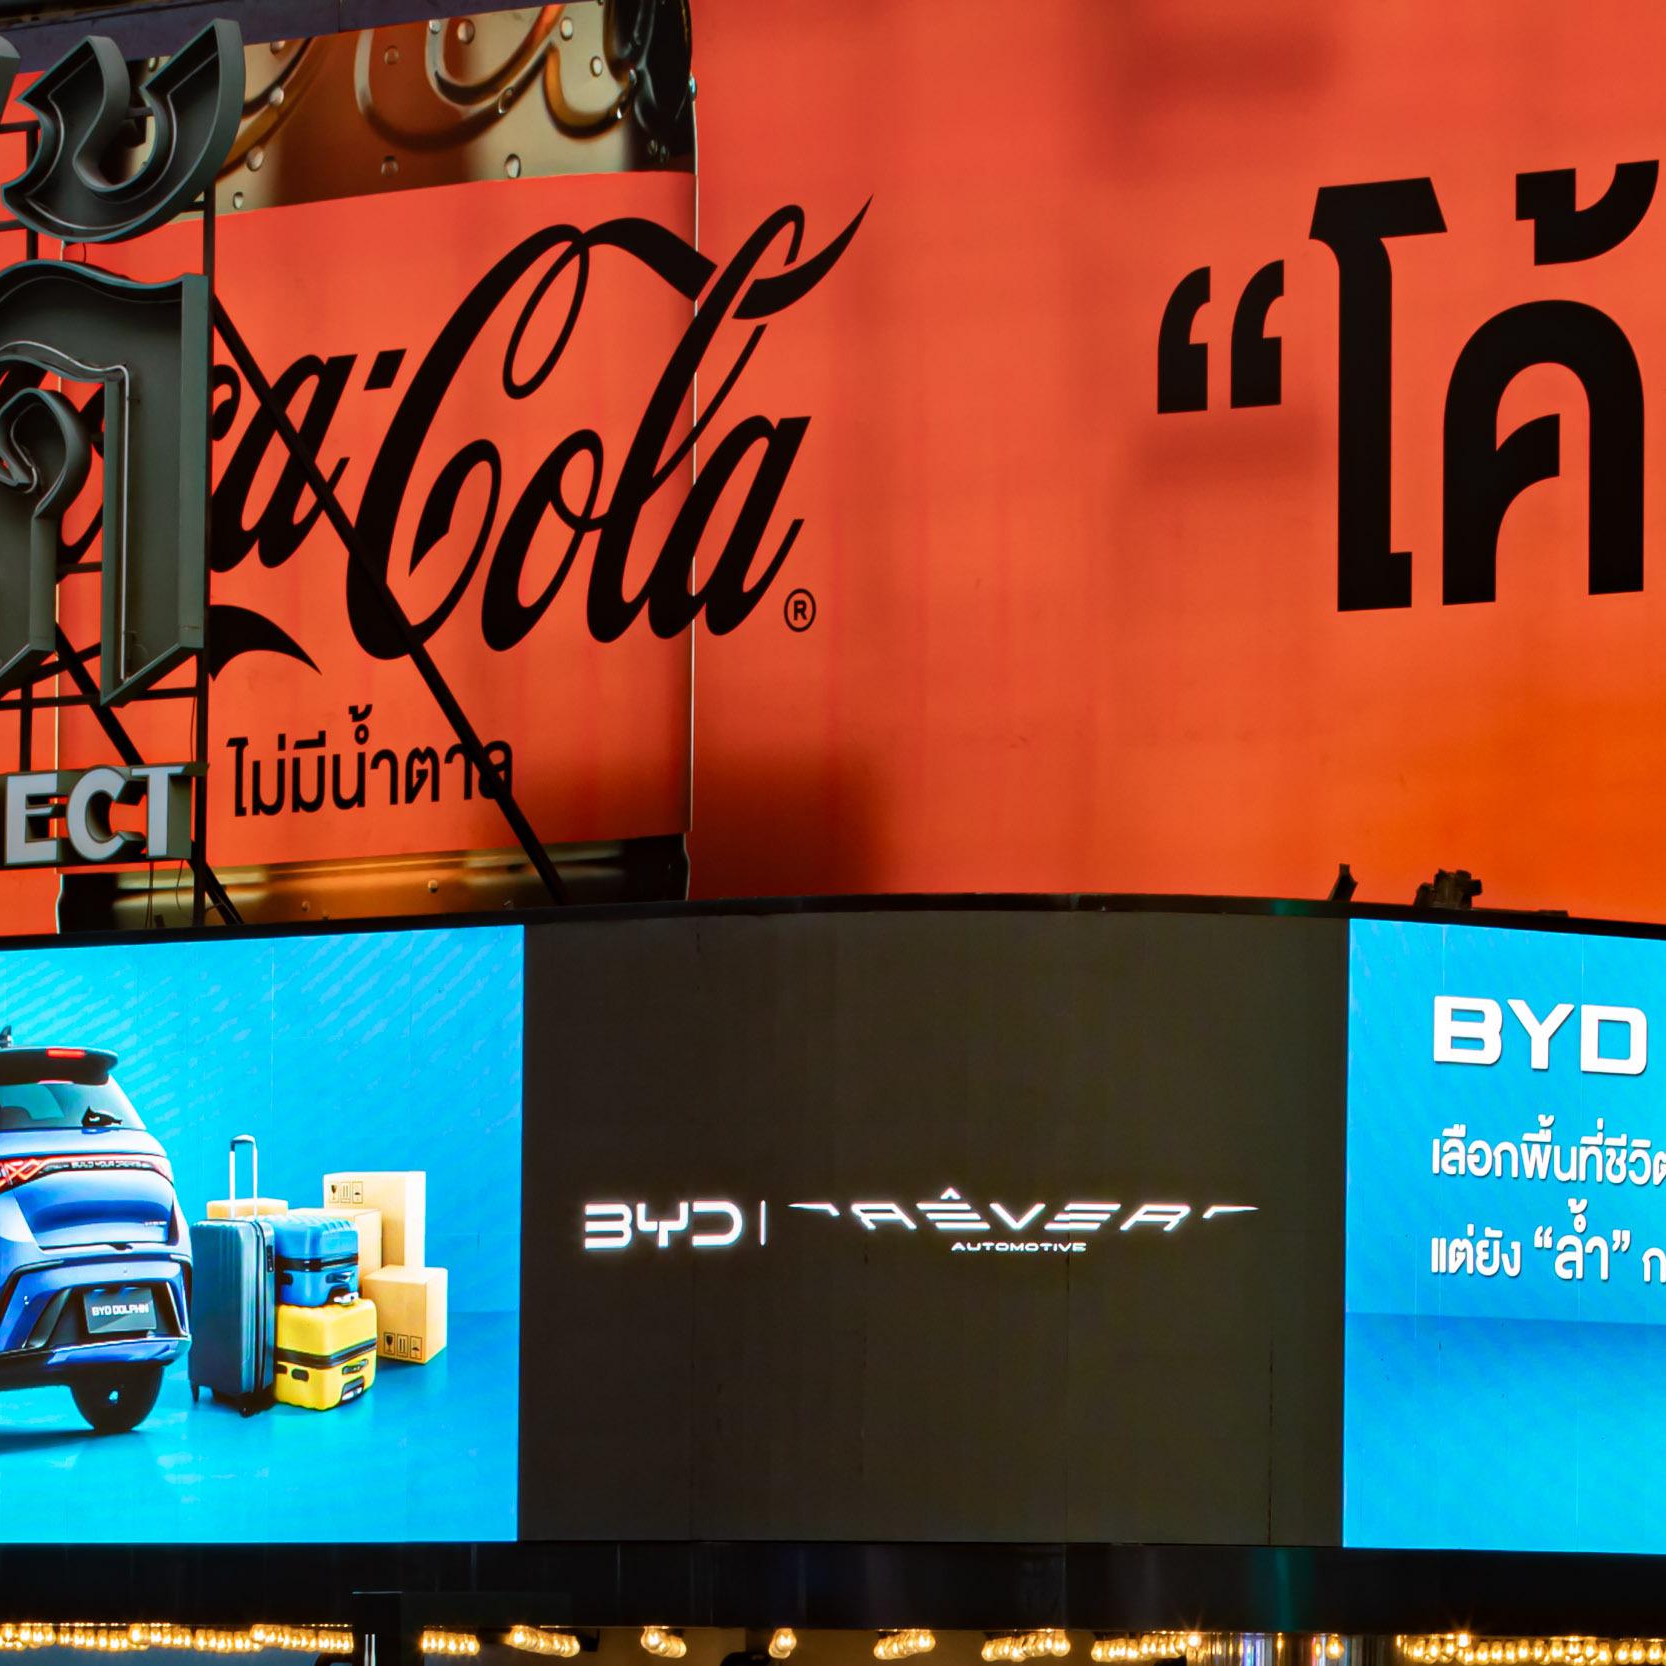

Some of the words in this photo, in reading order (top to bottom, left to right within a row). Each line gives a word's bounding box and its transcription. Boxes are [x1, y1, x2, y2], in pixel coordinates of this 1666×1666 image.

[226, 705, 515, 818] ไม่มีน้ำตาล
[1433, 995, 1647, 1075] BYD
[584, 1201, 743, 1249] BYD
[950, 1241, 1088, 1253] AUTOMOTIVE
[1431, 1224, 1522, 1280] แต่ยัง
[91, 1306, 112, 1318] BYD
[113, 1303, 150, 1316] DOLPHIN
